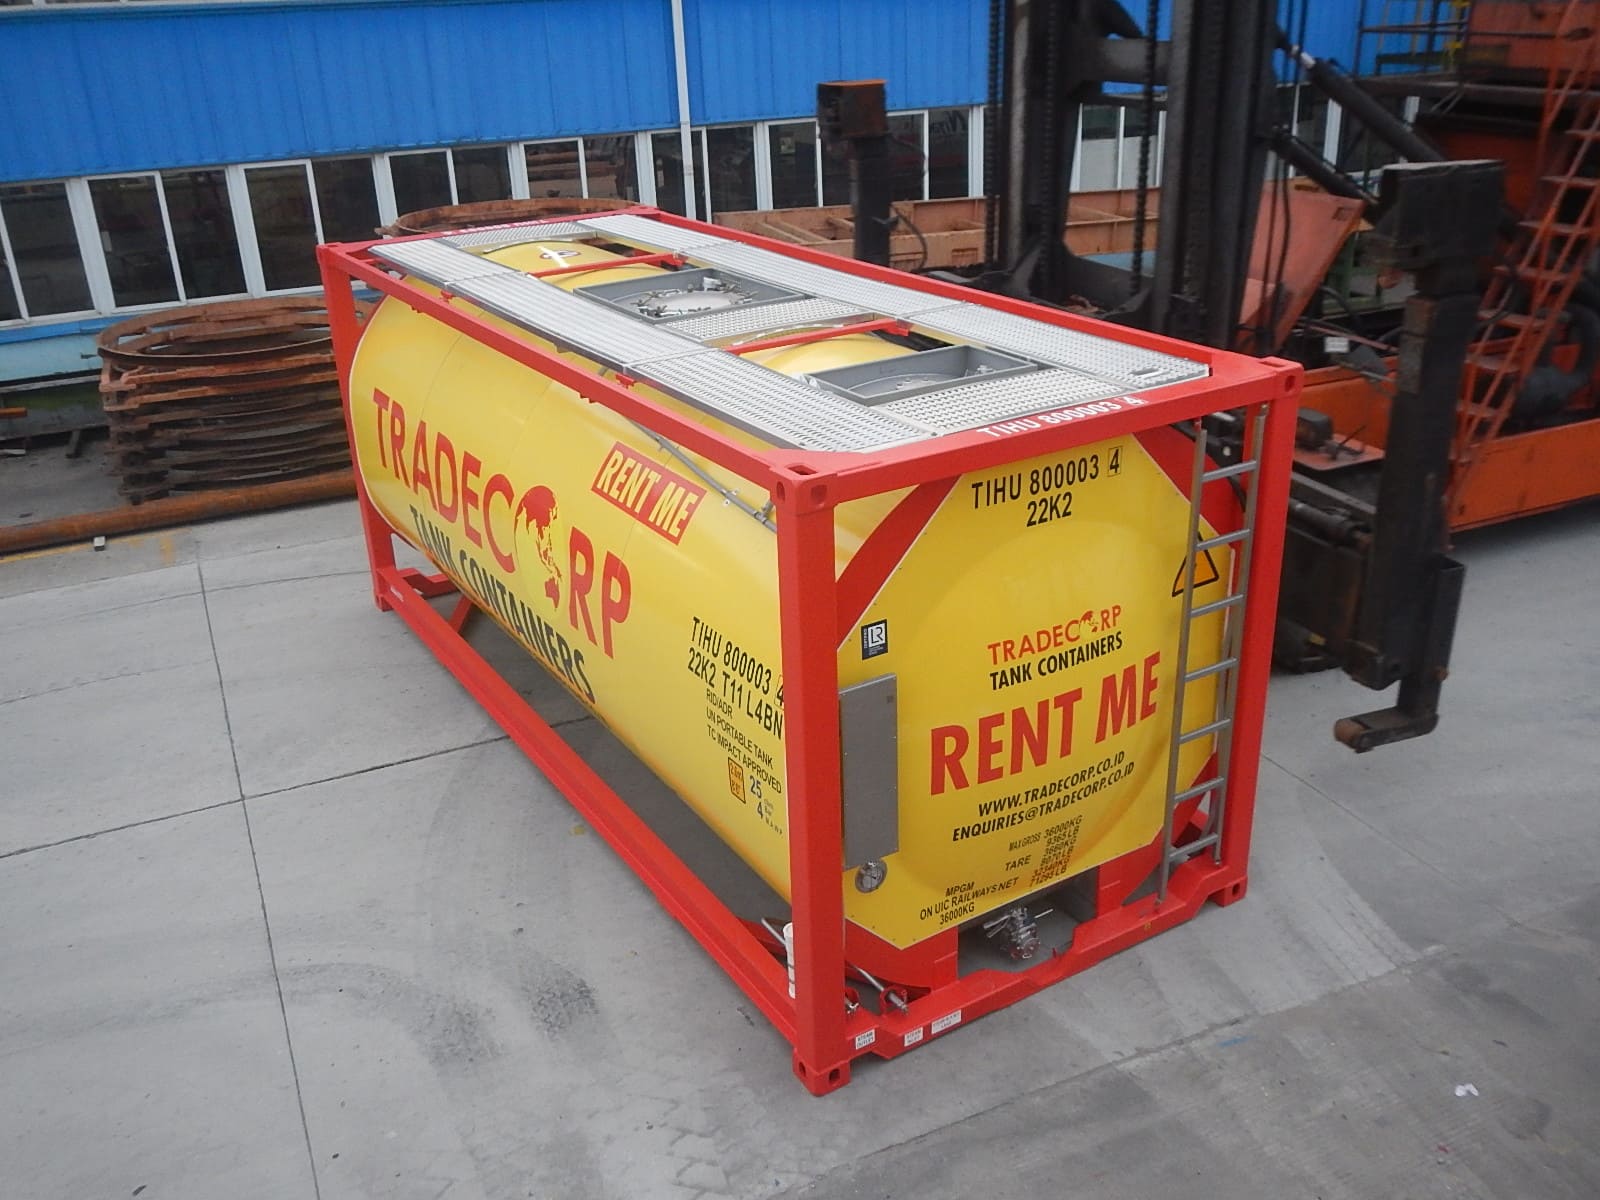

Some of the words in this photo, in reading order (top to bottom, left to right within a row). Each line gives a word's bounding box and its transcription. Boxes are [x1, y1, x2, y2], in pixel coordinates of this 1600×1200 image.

[976, 418, 1041, 437] TIHU
[1038, 401, 1121, 424] 800003
[597, 449, 662, 510] RENT
[648, 482, 699, 538] ME
[972, 473, 1022, 509] TIHU
[1029, 454, 1100, 495] 800003
[1109, 448, 1121, 475] 4
[1026, 492, 1073, 527] 22K2
[373, 387, 632, 660] TRADECORP
[409, 504, 460, 574] TANK
[459, 549, 596, 704] CONTAINERS
[987, 604, 1122, 666] TRADECORP
[691, 616, 722, 658] TIHU
[723, 641, 772, 695] 800003
[990, 663, 1032, 691] TANK
[1038, 631, 1122, 677] CONTAINERS
[688, 647, 717, 688] 22K2
[722, 671, 743, 709] T11
[746, 690, 783, 740] L4BN
[931, 687, 1082, 795] RENT
[1095, 651, 1161, 744] ME
[706, 707, 716, 726] UN
[716, 715, 753, 753] PORTABLE
[752, 743, 773, 770] TANK
[707, 724, 716, 741] TC
[717, 732, 742, 762] IMPACT
[742, 753, 782, 794] APPROVED
[749, 775, 762, 799] 25
[953, 761, 1135, 842] ENQUIRIES@TRADECORP.CO.ID
[979, 750, 1125, 817] WWW.TRADECORP.CO.ID
[945, 881, 975, 897] MPGM
[998, 877, 1019, 892] NET
[1004, 855, 1031, 871] TARE
[920, 907, 933, 921] ON
[935, 899, 950, 914] UIC
[951, 884, 998, 907] RAILWAYS
[940, 902, 975, 926] 36000KG
